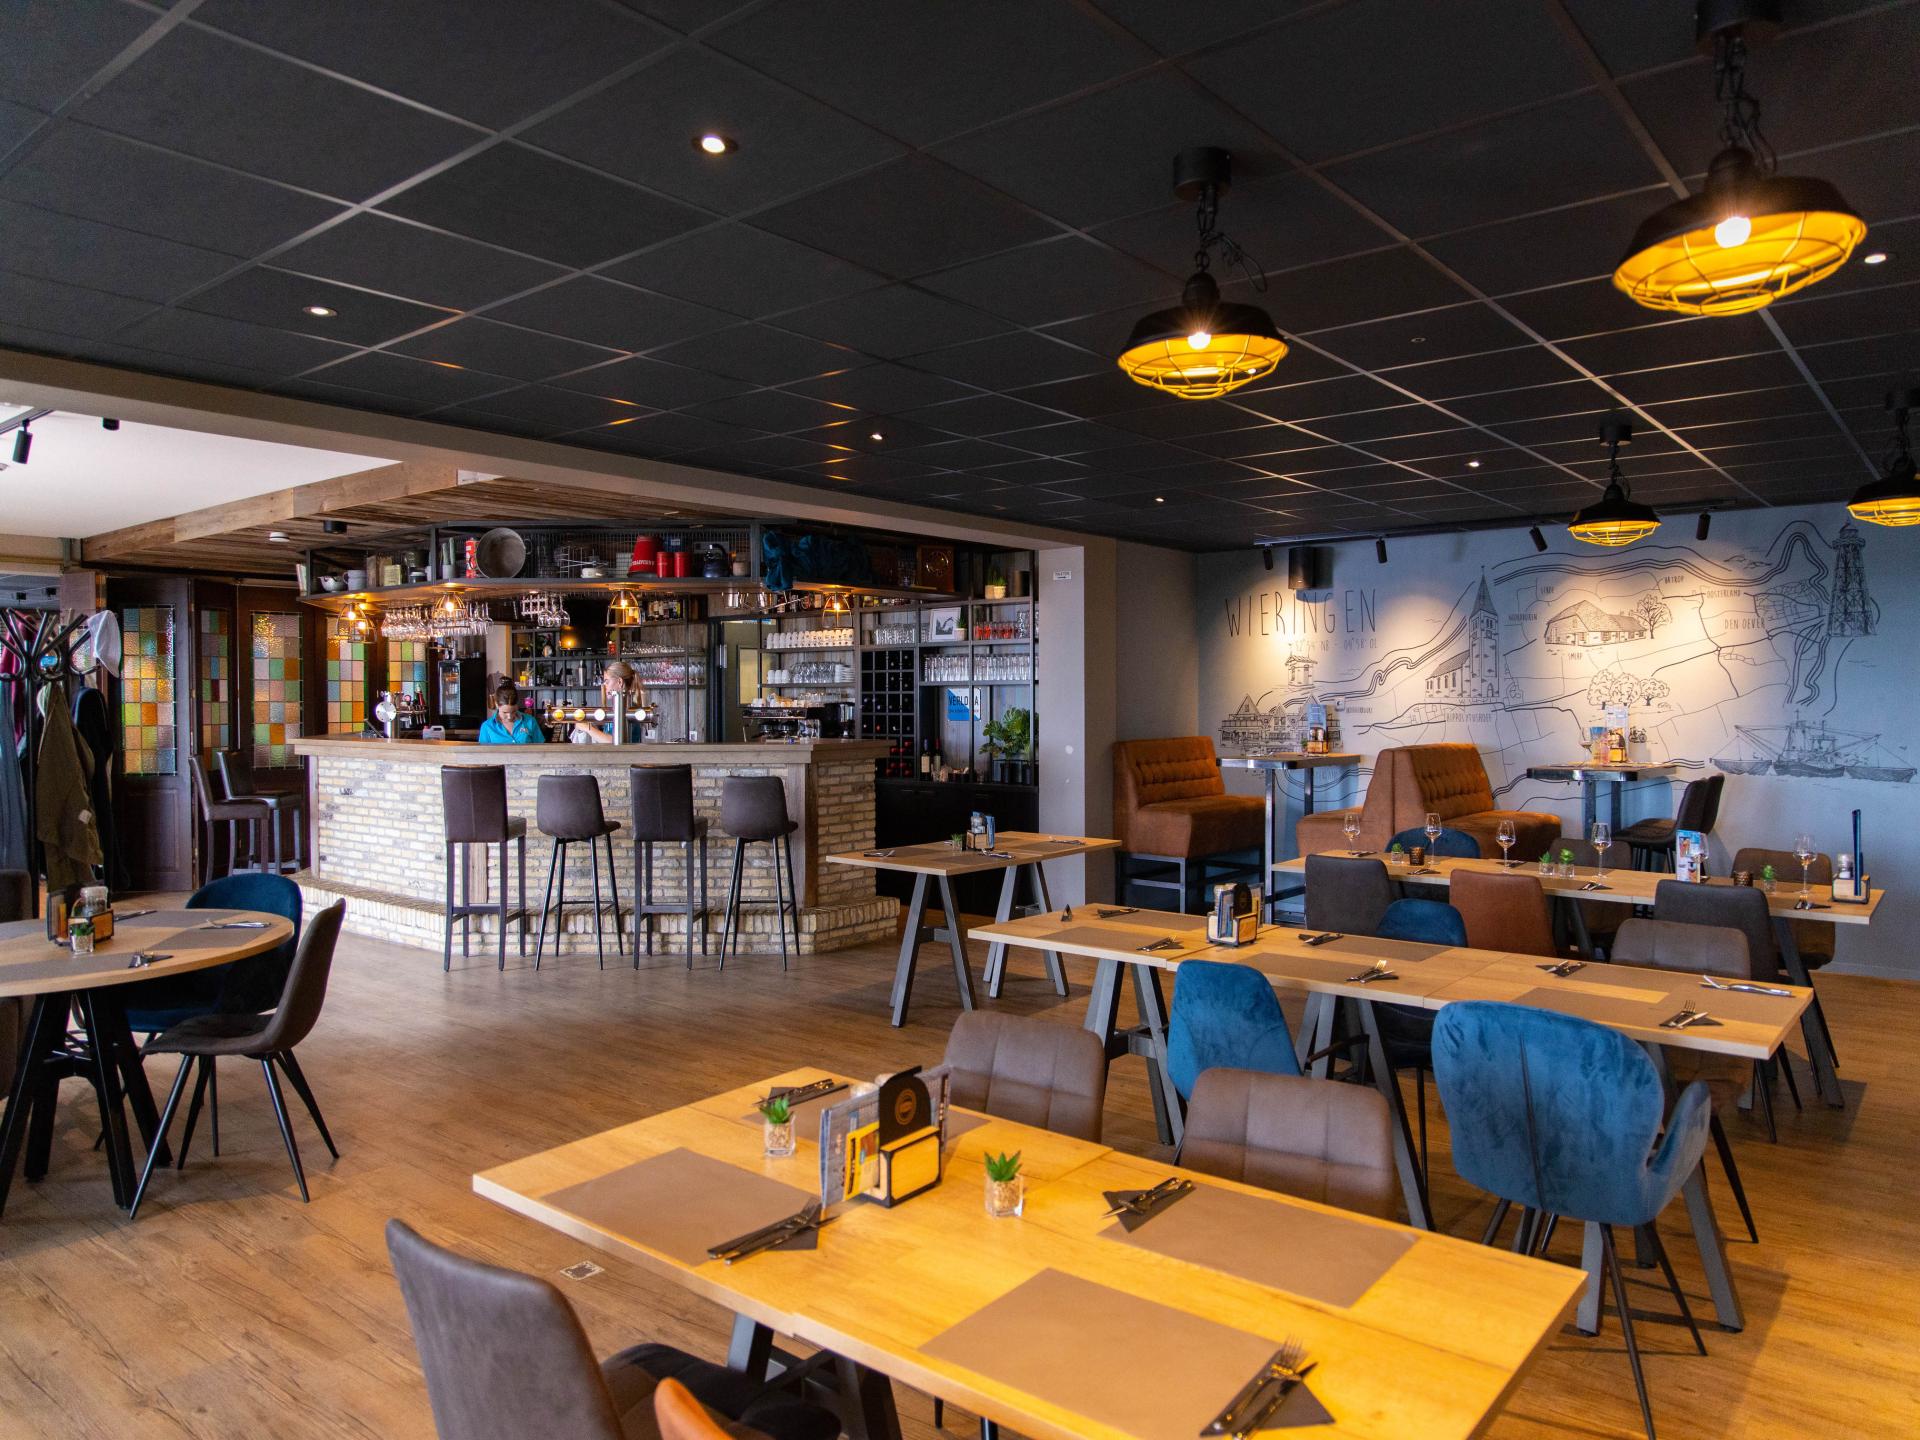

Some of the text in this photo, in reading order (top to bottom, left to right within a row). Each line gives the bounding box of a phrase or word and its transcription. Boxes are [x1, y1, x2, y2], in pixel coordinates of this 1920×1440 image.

[1706, 589, 1741, 599] OOSTERLAND
[1225, 589, 1376, 637] WIERINGEN
[1724, 617, 1765, 630] DEN OEVER
[948, 695, 979, 706] VERLOA
